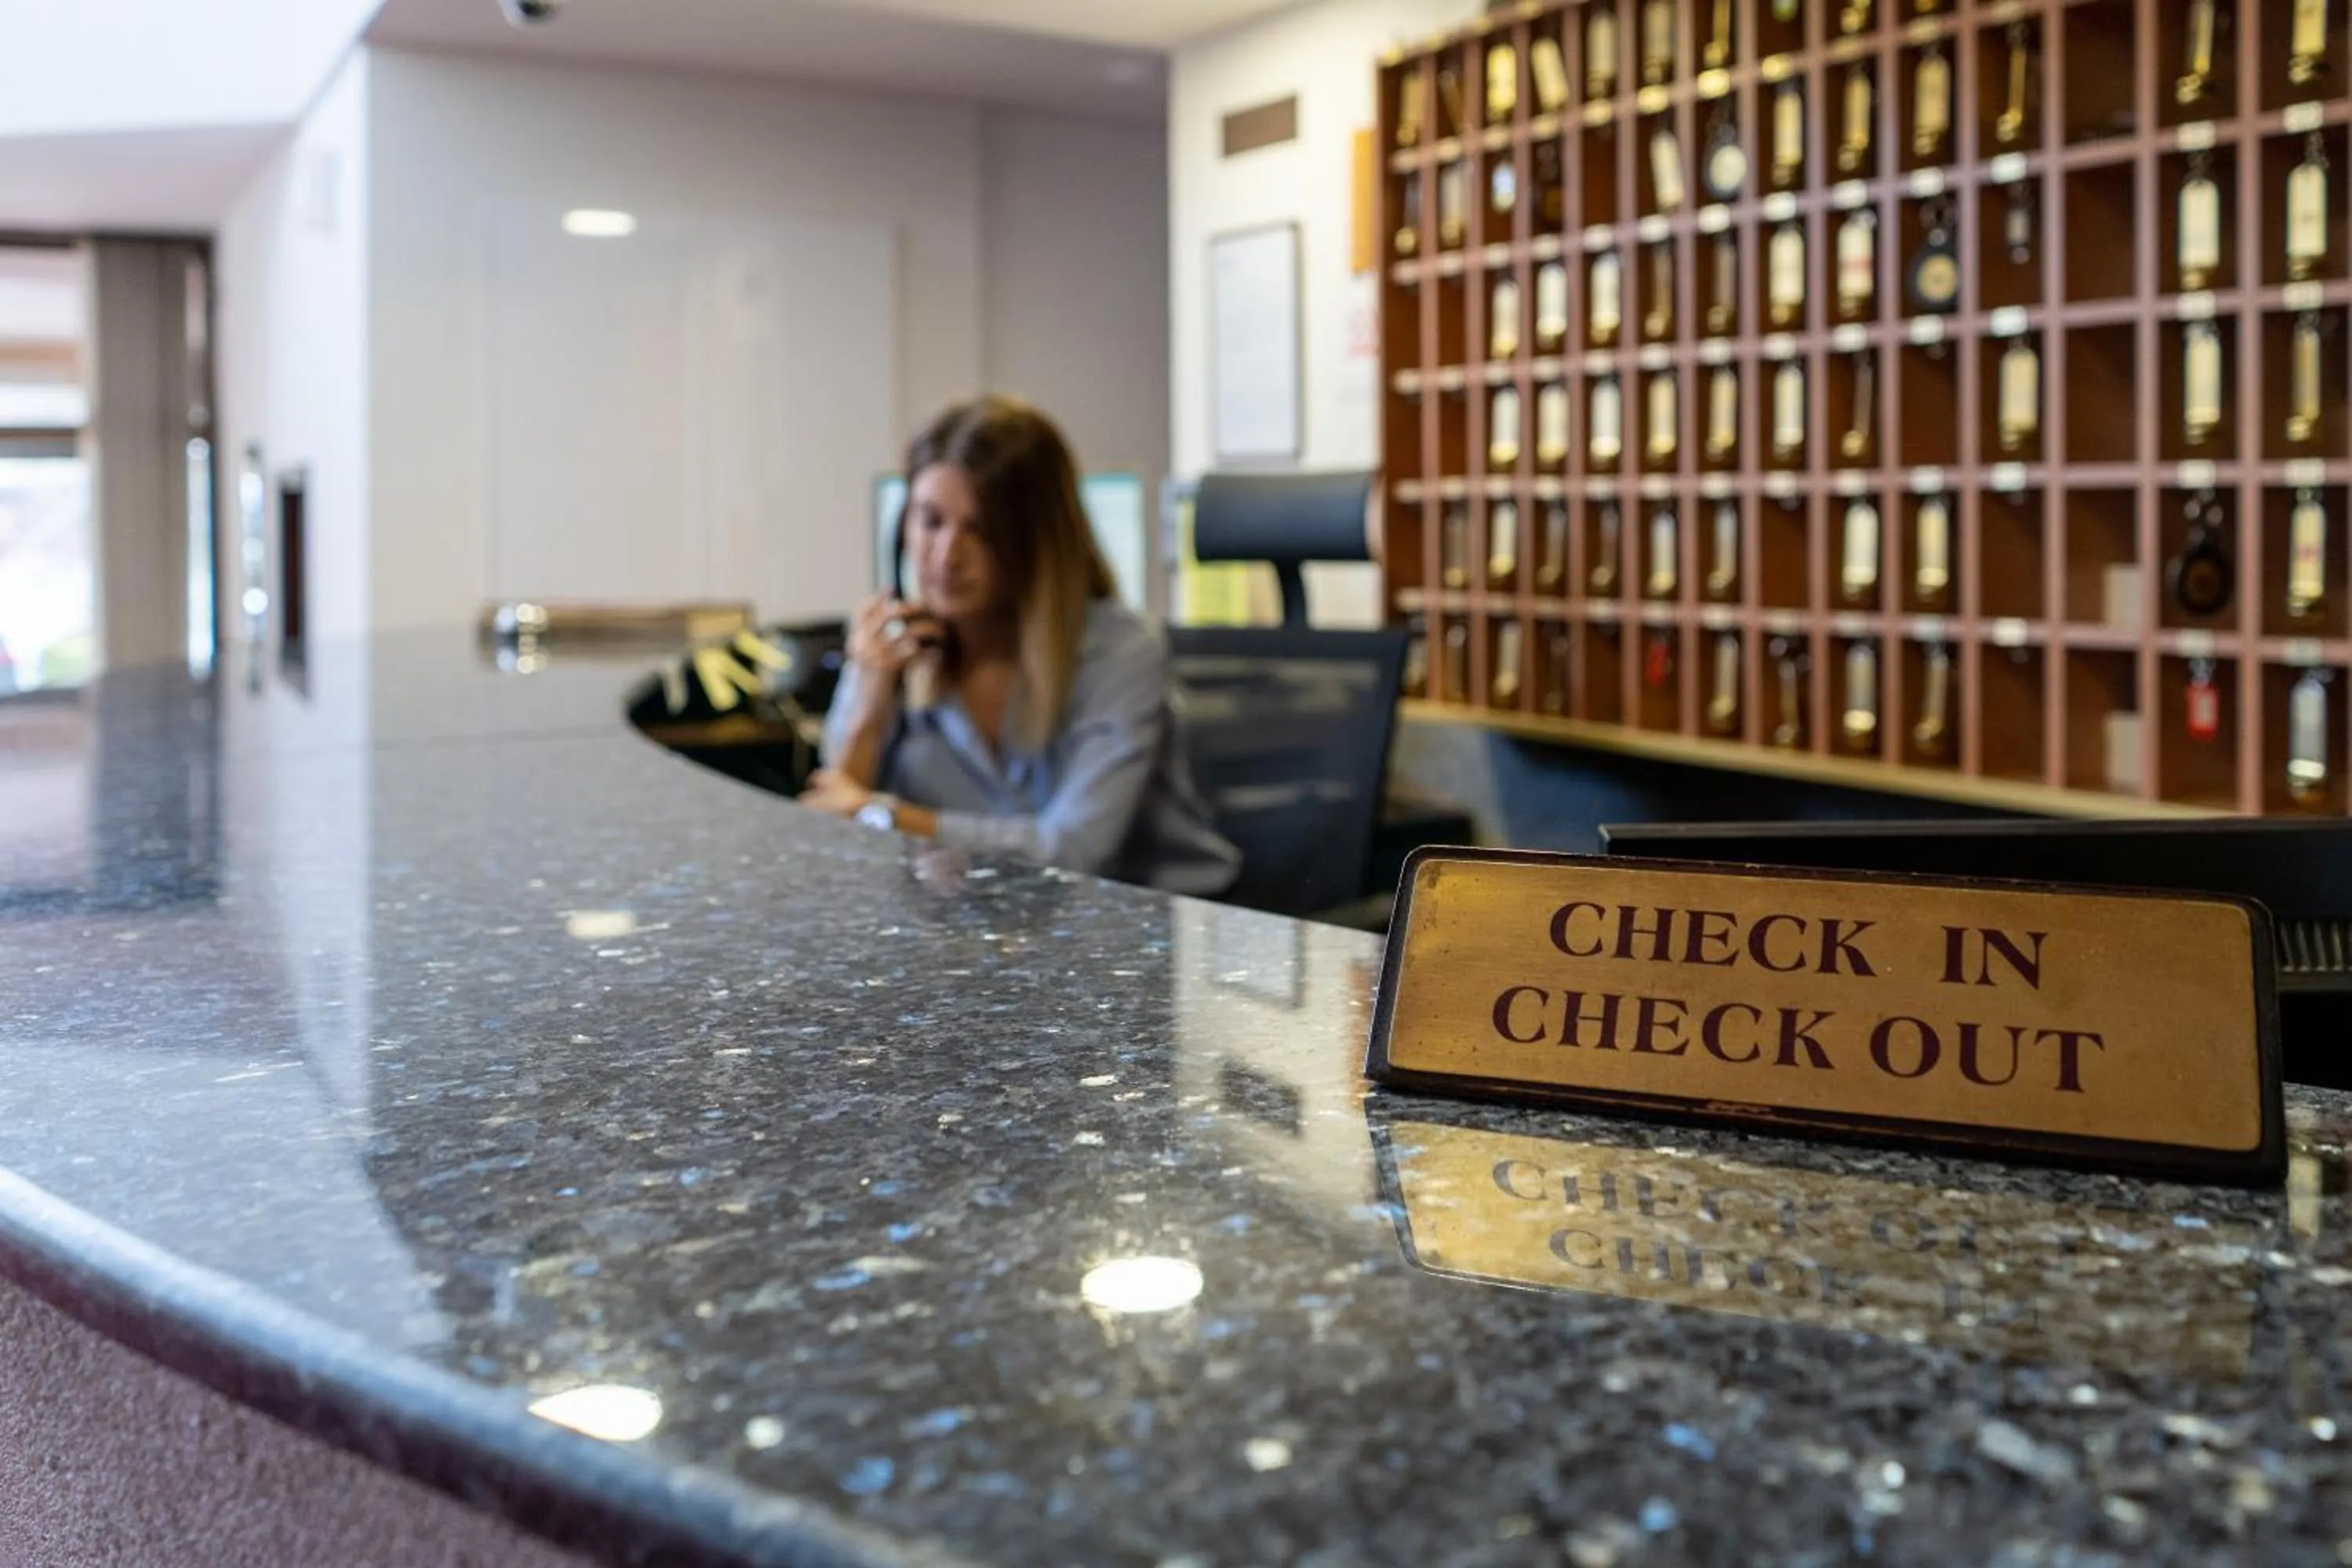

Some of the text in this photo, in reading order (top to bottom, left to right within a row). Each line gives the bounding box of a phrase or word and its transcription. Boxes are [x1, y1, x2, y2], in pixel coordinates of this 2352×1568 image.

[1550, 902, 2048, 989] CHECK IN
[1492, 986, 2106, 1093] CHECK OUT
